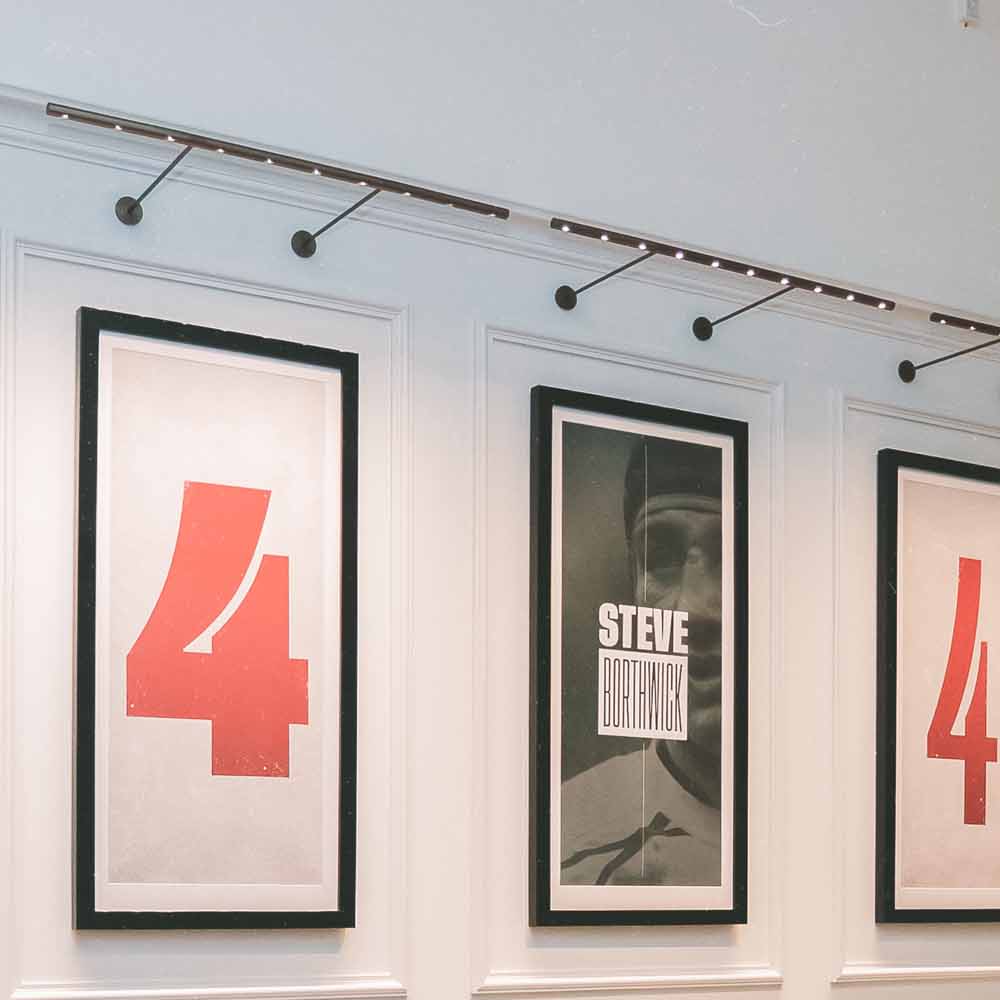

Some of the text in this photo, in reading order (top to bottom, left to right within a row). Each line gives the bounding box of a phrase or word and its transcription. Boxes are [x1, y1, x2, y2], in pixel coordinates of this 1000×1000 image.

[126, 481, 308, 777] 4
[598, 602, 689, 654] STEVE
[603, 657, 683, 732] BORTHWICK
[927, 556, 998, 825] 4
